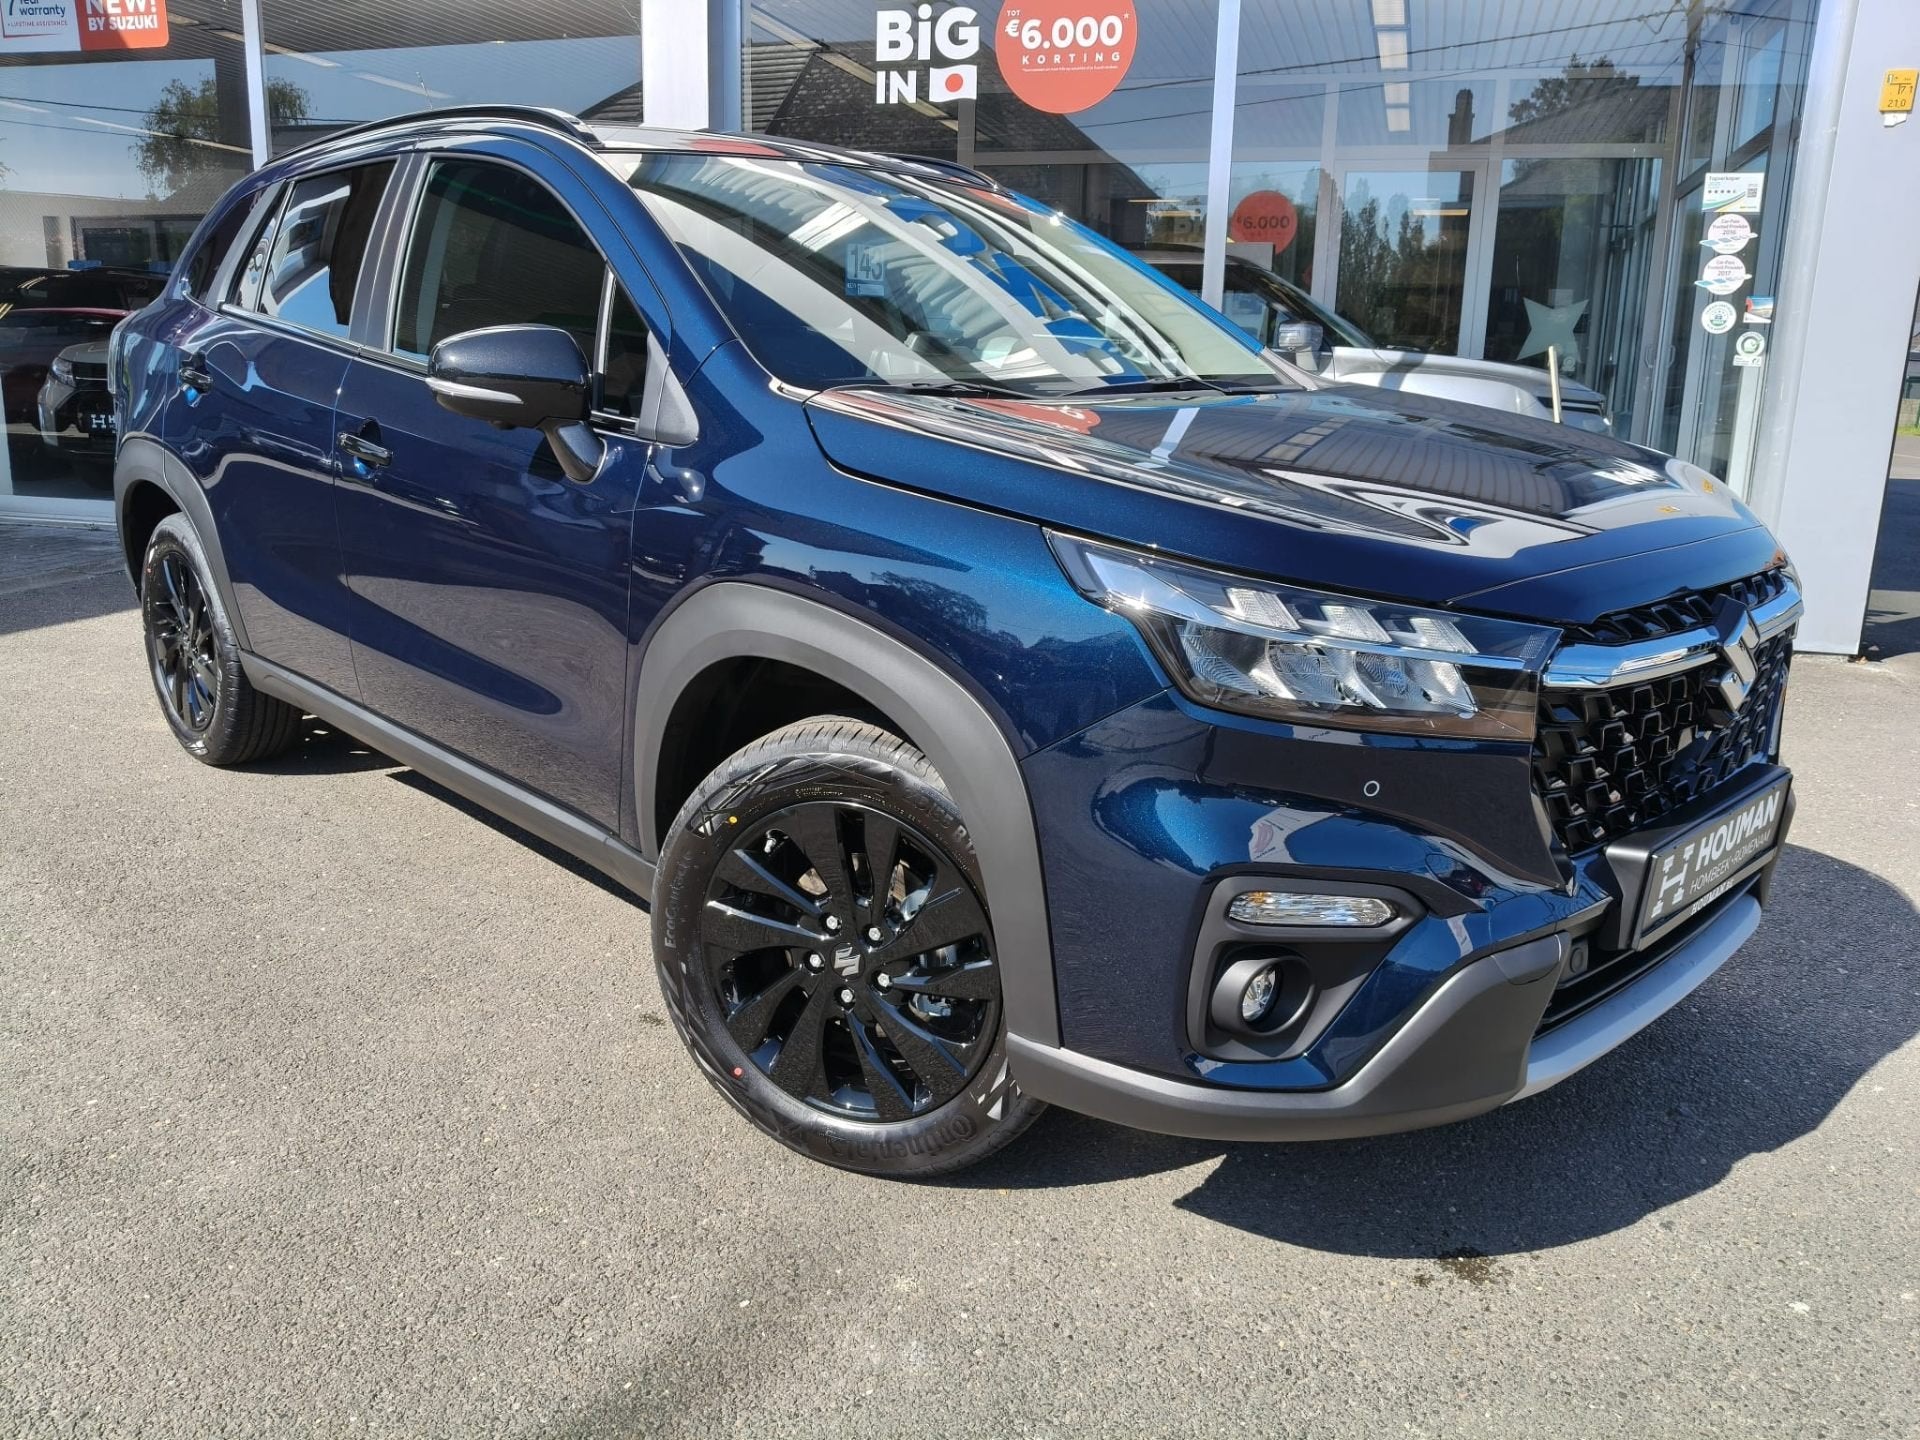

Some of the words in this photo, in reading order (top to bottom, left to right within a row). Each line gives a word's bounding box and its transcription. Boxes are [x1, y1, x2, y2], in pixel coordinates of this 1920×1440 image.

[19, 4, 66, 17] warranty
[1007, 9, 1021, 17] TOT
[88, 18, 106, 31] BY
[109, 15, 158, 30] SUZUKI
[876, 3, 980, 62] BiG
[1022, 51, 1120, 65] KORTING
[876, 70, 917, 104] IN
[1695, 791, 1780, 871] HOUMAN
